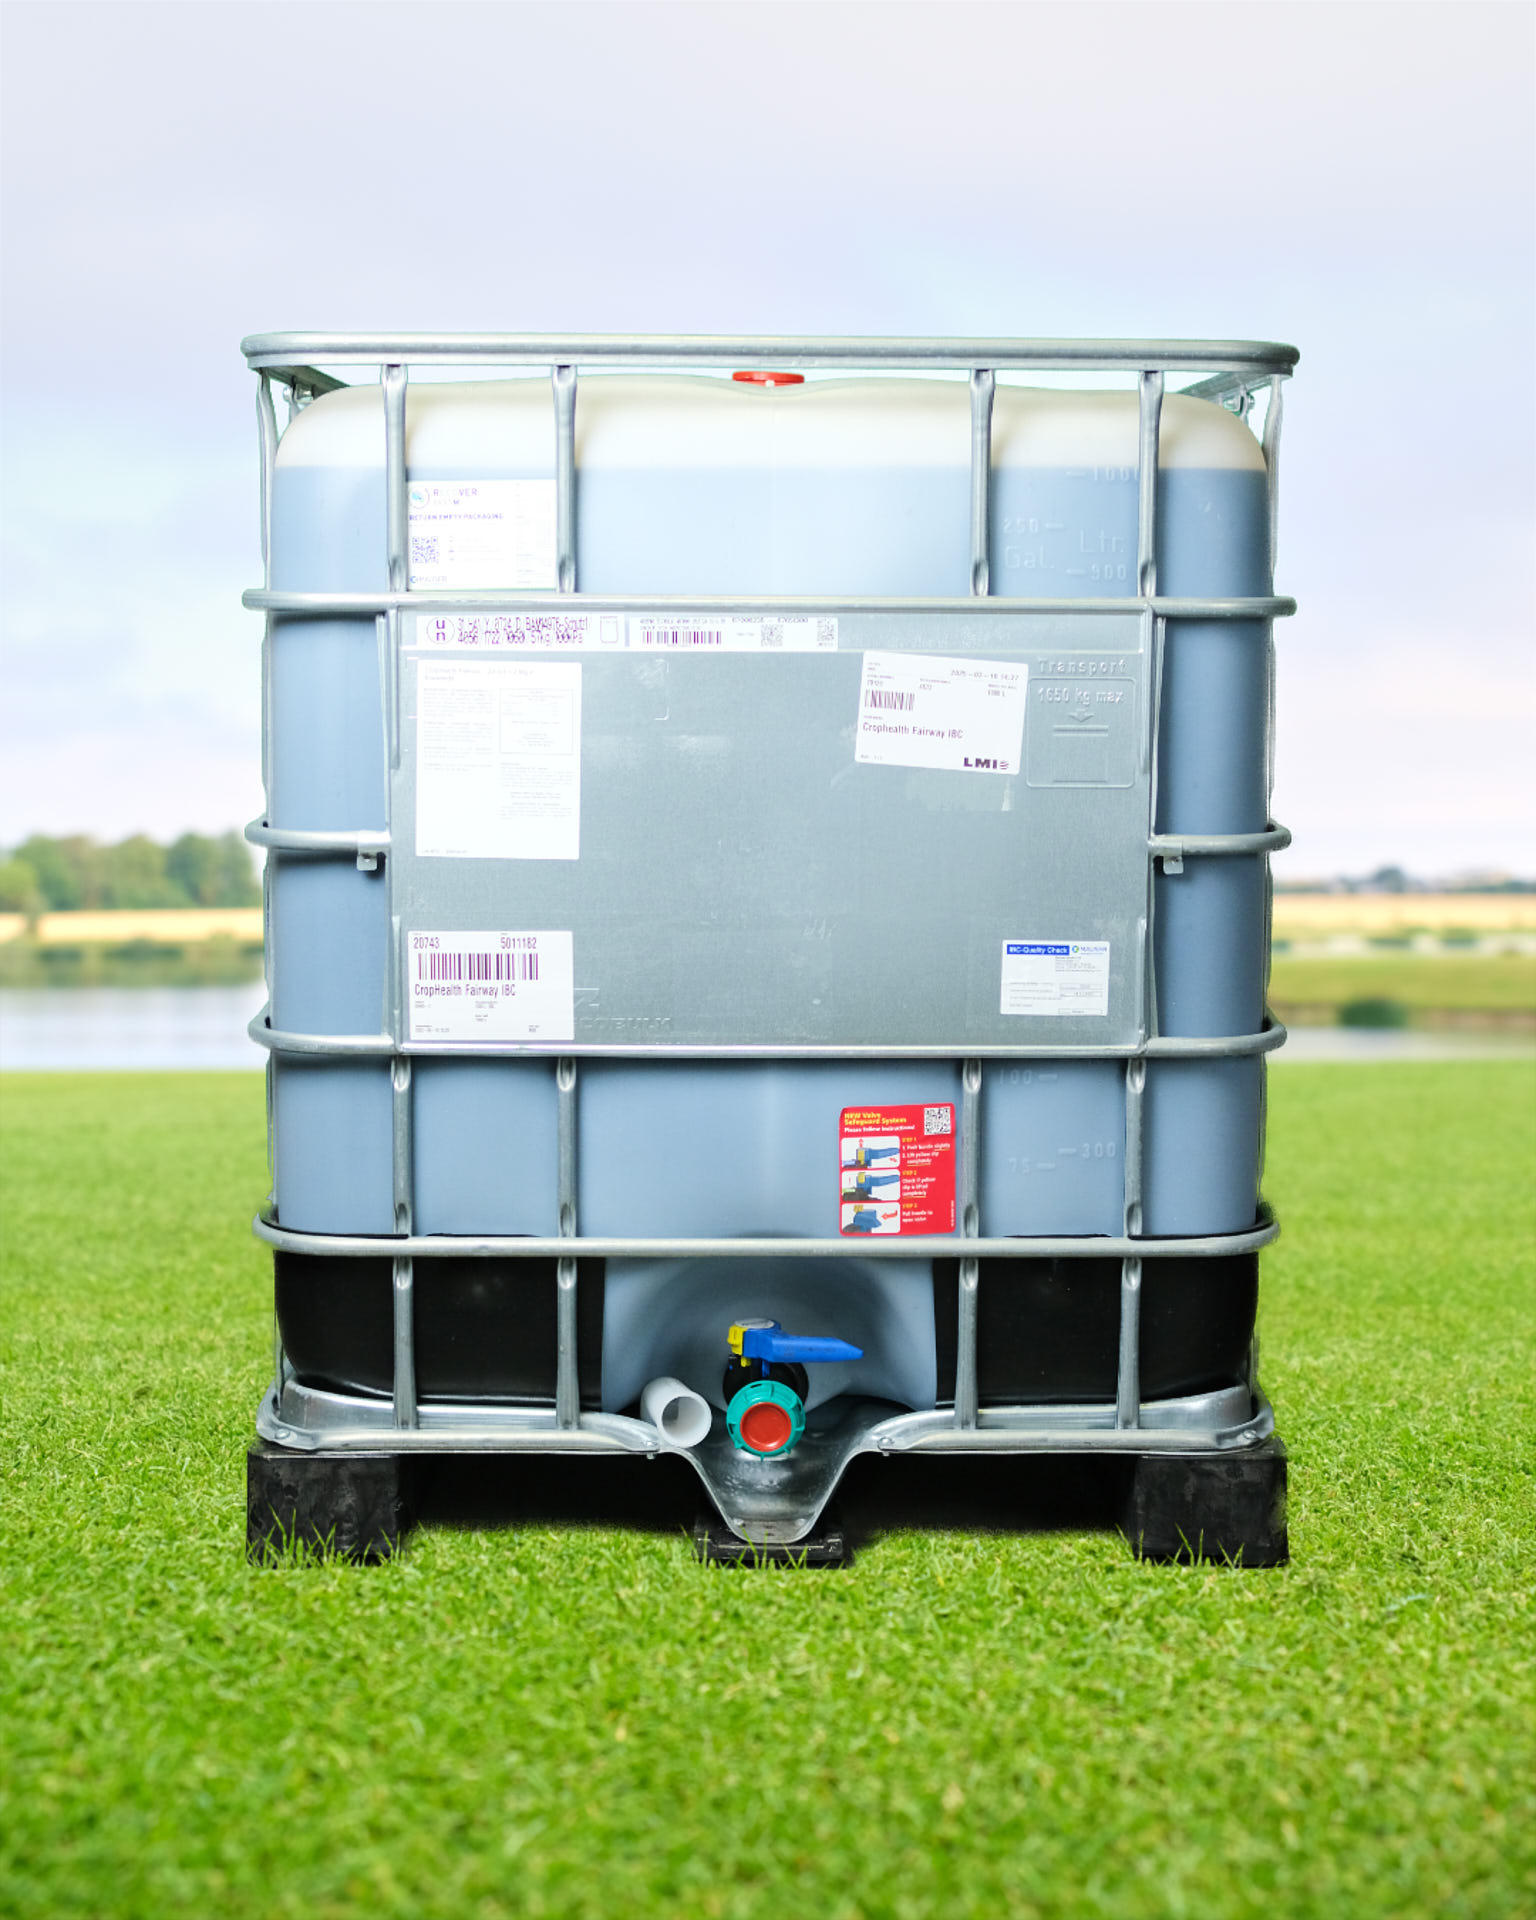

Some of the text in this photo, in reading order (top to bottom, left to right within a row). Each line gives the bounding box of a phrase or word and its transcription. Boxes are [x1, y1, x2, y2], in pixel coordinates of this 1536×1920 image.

[1002, 518, 1039, 534] 250
[1005, 546, 1056, 569] Gal.
[1090, 563, 1127, 581] 900
[1037, 657, 1128, 676] Transport
[1038, 687, 1125, 706] 1650 kg max
[863, 722, 964, 739] Crophealth Fairway IBC
[963, 757, 998, 769] LMI
[413, 936, 440, 950] 20743
[1047, 946, 1068, 954] Check
[414, 984, 516, 997] CropHealth Fairway IBC
[844, 1118, 880, 1126] Safeguard
[1081, 1142, 1117, 1159] 300
